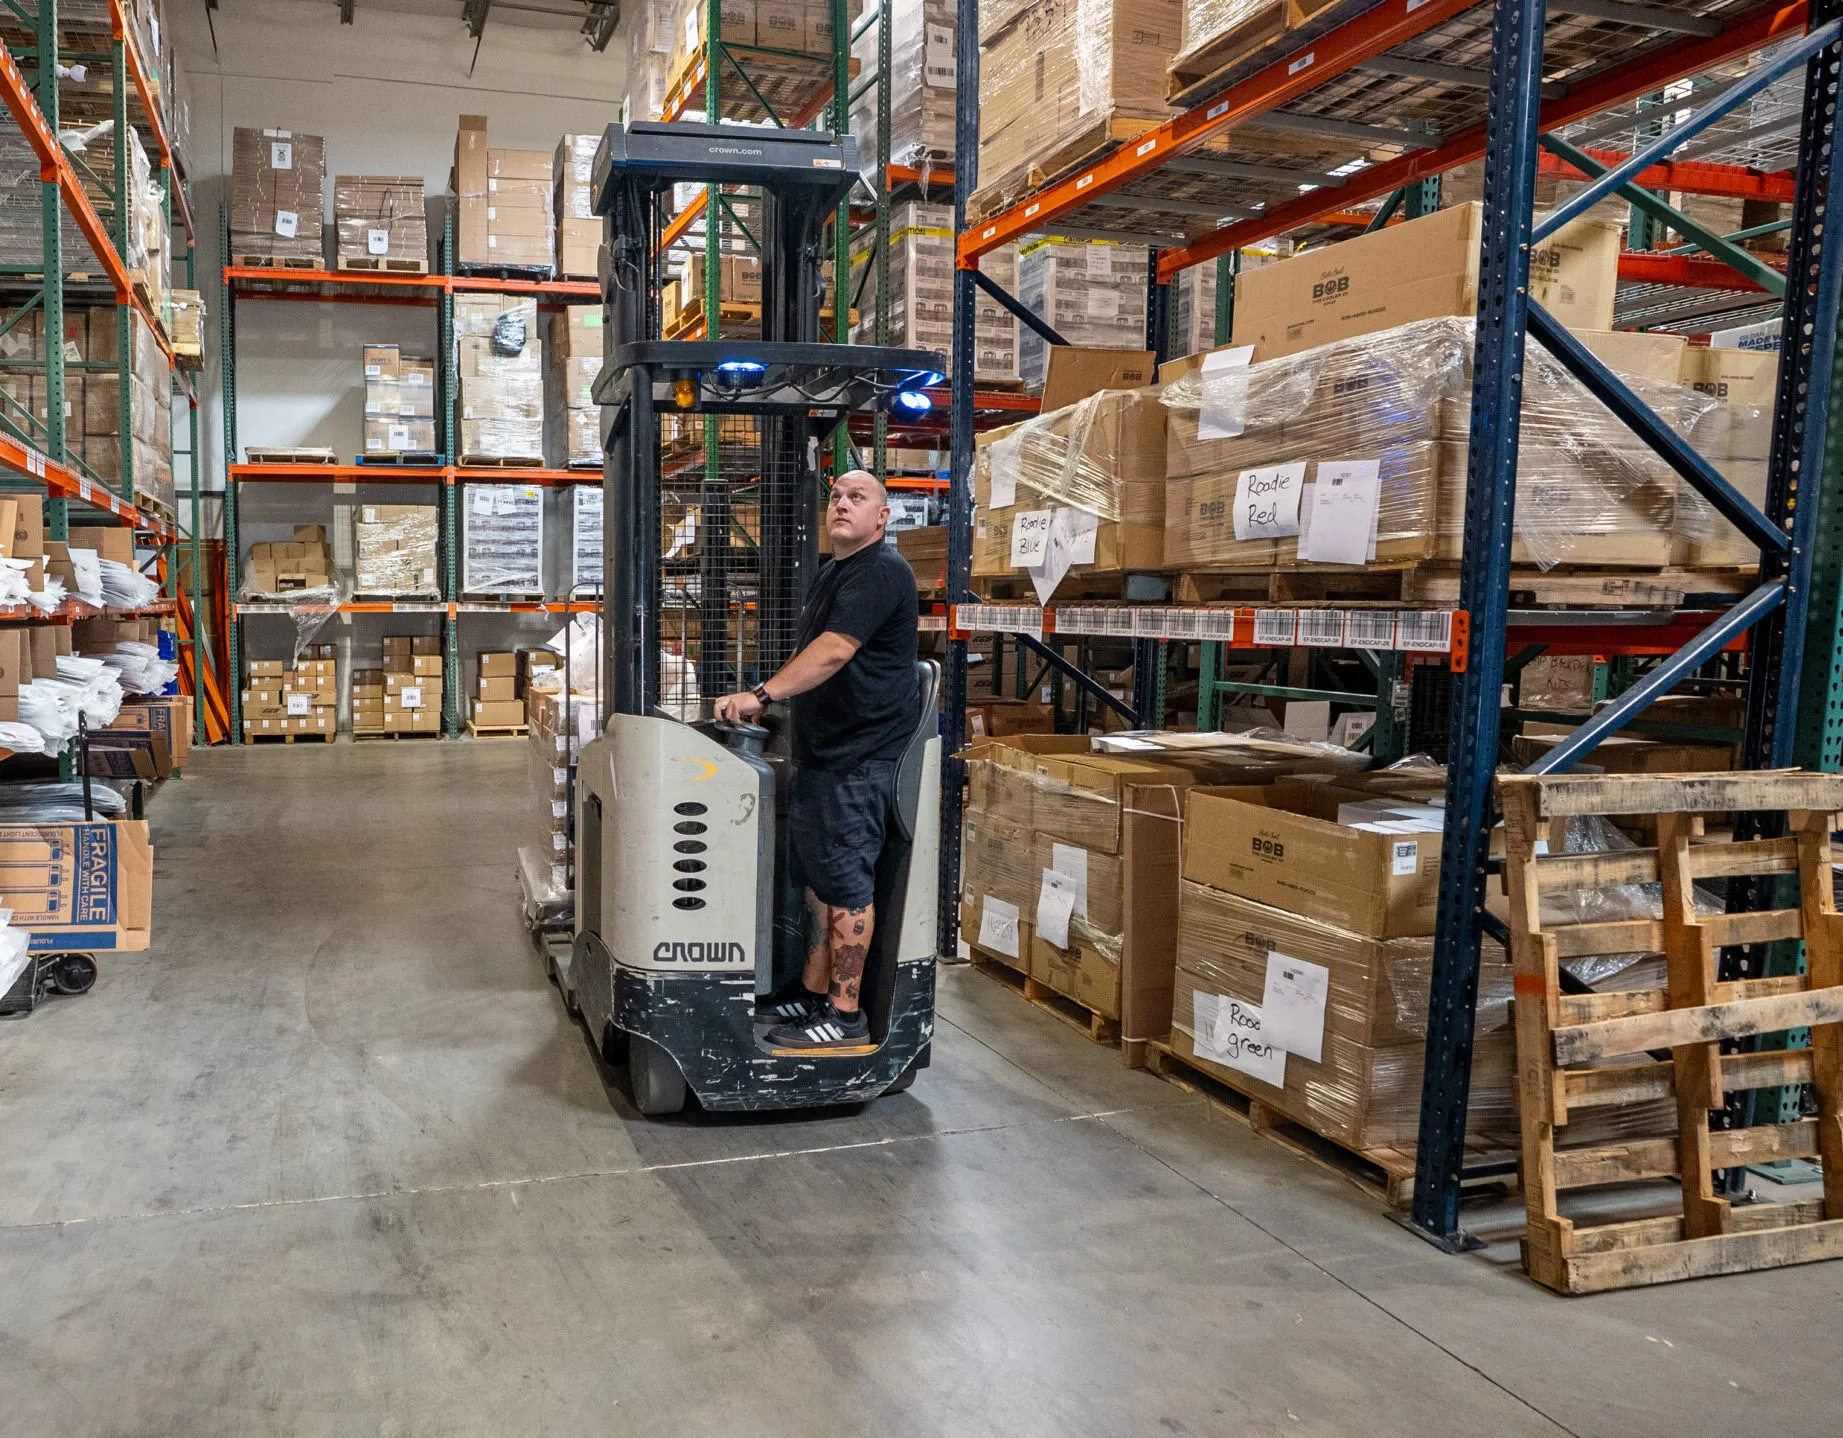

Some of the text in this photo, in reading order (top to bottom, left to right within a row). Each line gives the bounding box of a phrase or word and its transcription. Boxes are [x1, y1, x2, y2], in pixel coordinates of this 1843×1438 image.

[708, 146, 763, 156] crown.com
[1312, 276, 1350, 299] BOB
[1738, 335, 1772, 349] MADE
[1693, 382, 1728, 398] BOB
[1247, 472, 1291, 499] Roadie
[1200, 501, 1225, 515] BOB
[1248, 502, 1279, 529] Red
[1019, 538, 1041, 555] Blue
[1403, 641, 1447, 649] EF-ENDCAP-1R
[1252, 836, 1284, 857] BOB
[80, 828, 91, 921] HANDLE WITH CARE
[89, 828, 108, 921] FRAGILE
[653, 942, 745, 962] CROWN
[1227, 1032, 1273, 1060] green
